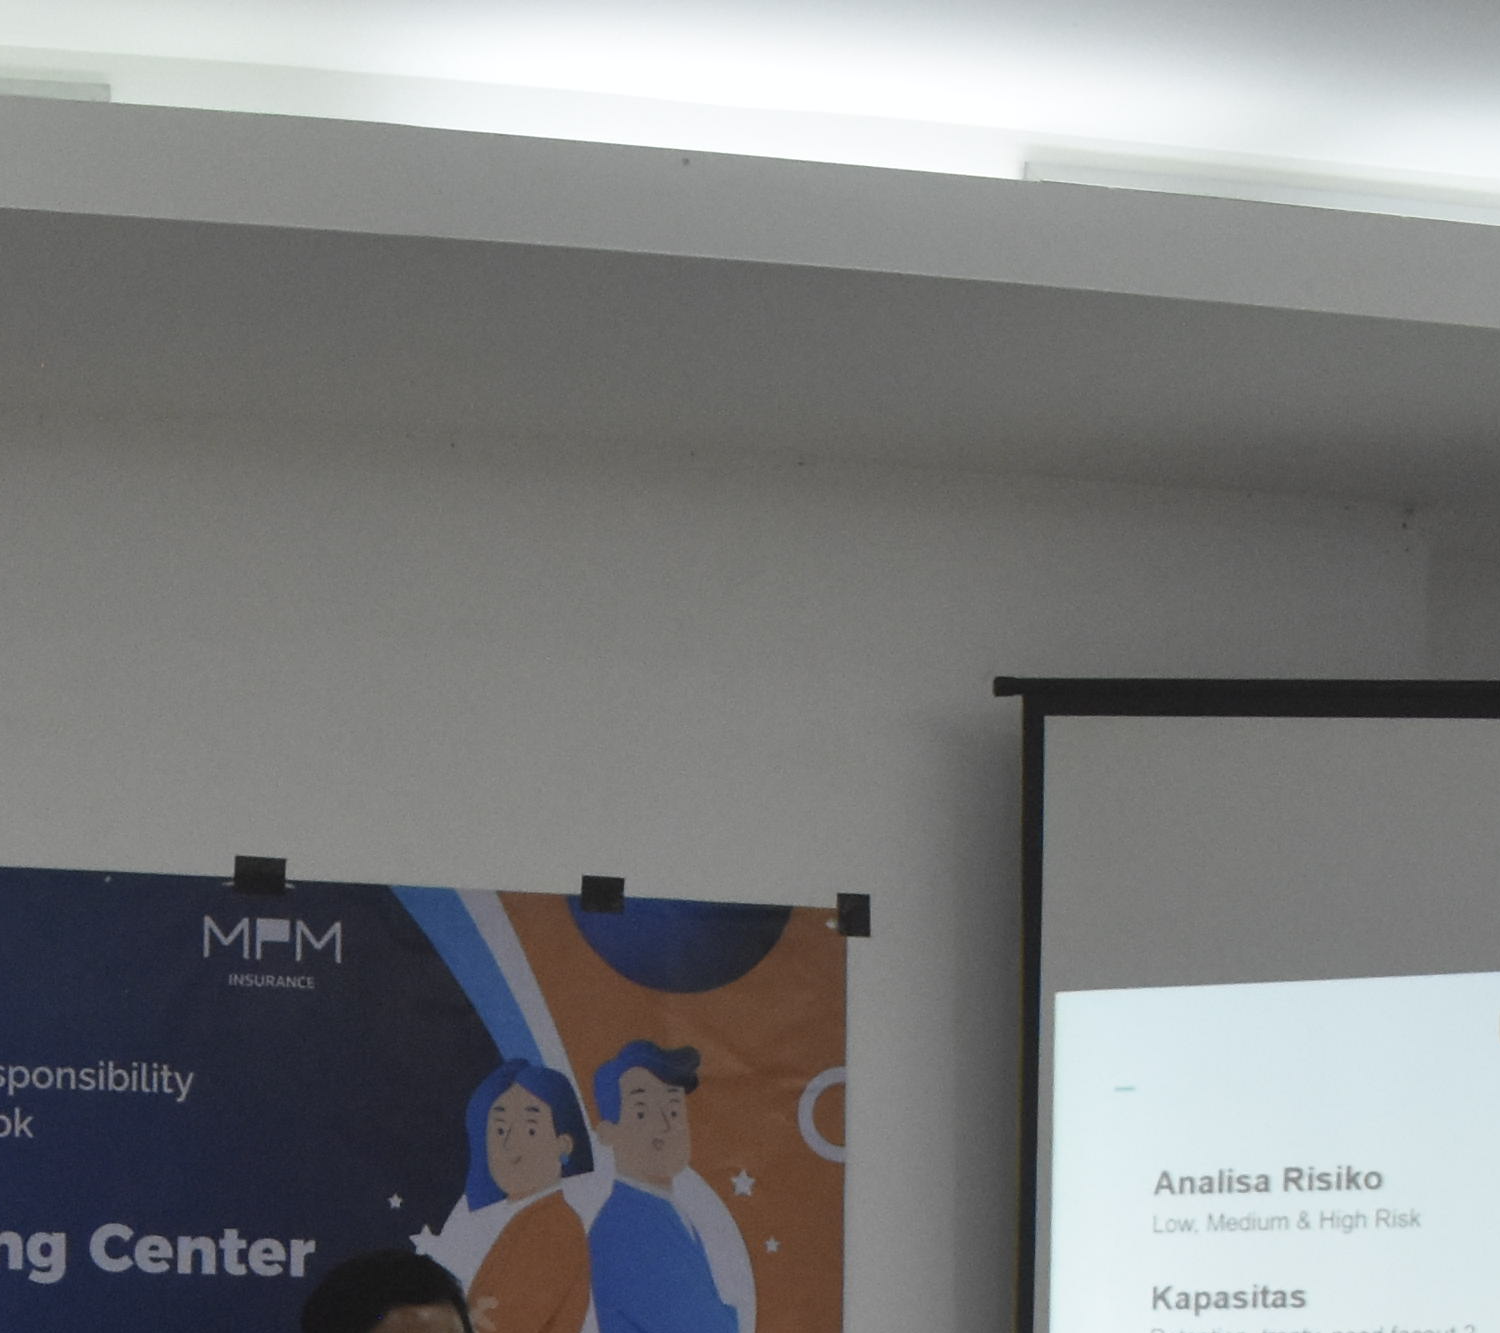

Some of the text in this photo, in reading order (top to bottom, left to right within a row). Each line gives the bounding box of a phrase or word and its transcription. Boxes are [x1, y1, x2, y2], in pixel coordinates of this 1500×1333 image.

[203, 915, 342, 964] MPM
[228, 973, 315, 990] INSURANCE
[1154, 1165, 1384, 1195] Analisa Risiko
[1207, 1213, 1291, 1232] Medium
[1297, 1211, 1311, 1230] &
[1319, 1210, 1368, 1234] High
[1375, 1208, 1421, 1229] Risk
[89, 1223, 316, 1278] Center
[1152, 1285, 1307, 1316] Kapasitas
